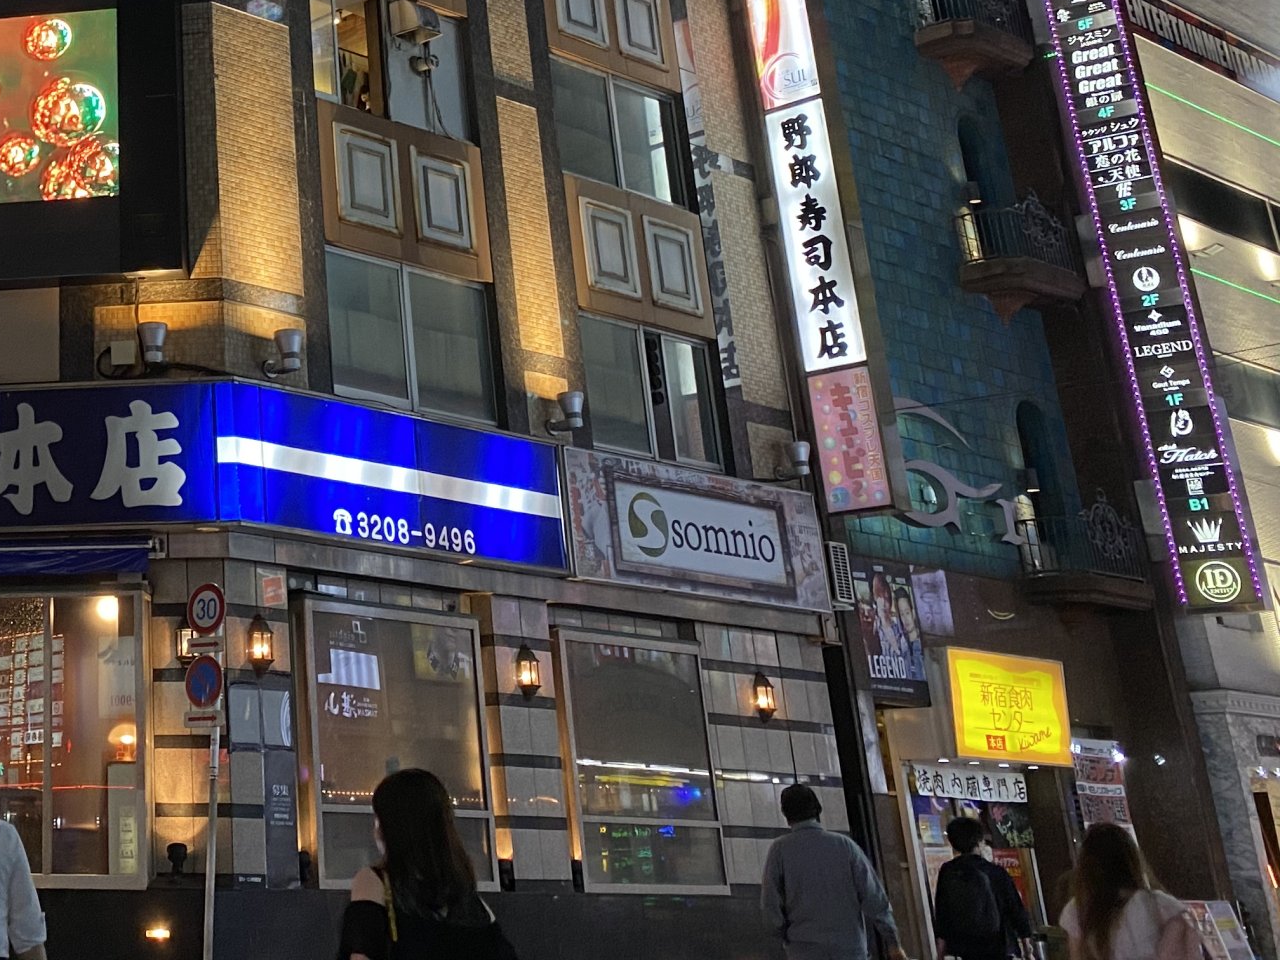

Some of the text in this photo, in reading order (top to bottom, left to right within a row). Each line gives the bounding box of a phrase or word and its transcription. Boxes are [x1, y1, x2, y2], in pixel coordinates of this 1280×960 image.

[1077, 15, 1094, 31] 5F
[1067, 28, 1112, 45] ジャスミン
[1071, 43, 1116, 64] Great
[1075, 58, 1119, 80] Great
[1078, 73, 1123, 95] Great
[1097, 105, 1115, 118] 4F
[1110, 117, 1140, 132] シュウ
[1088, 133, 1140, 154] アルファ
[1095, 148, 1142, 169] 恋の花
[1108, 164, 1142, 182] 天使
[1120, 197, 1137, 211] 3F
[1108, 218, 1160, 234] Centenario
[780, 113, 850, 361] 野郎寿司本店
[1114, 244, 1166, 261] Centenario
[1141, 293, 1160, 307] 2F
[1133, 340, 1194, 358] LEGEND
[1165, 393, 1184, 406] 1F
[1188, 497, 1210, 512] B1
[357, 511, 477, 555] 3208-9496
[672, 518, 776, 563] somnio
[1178, 541, 1245, 555] MAJESTY
[195, 598, 217, 621] 30
[867, 655, 907, 678] LEGEND
[980, 682, 1033, 711] 新宿食肉
[990, 708, 1035, 732] センター
[988, 736, 1004, 750] 本店
